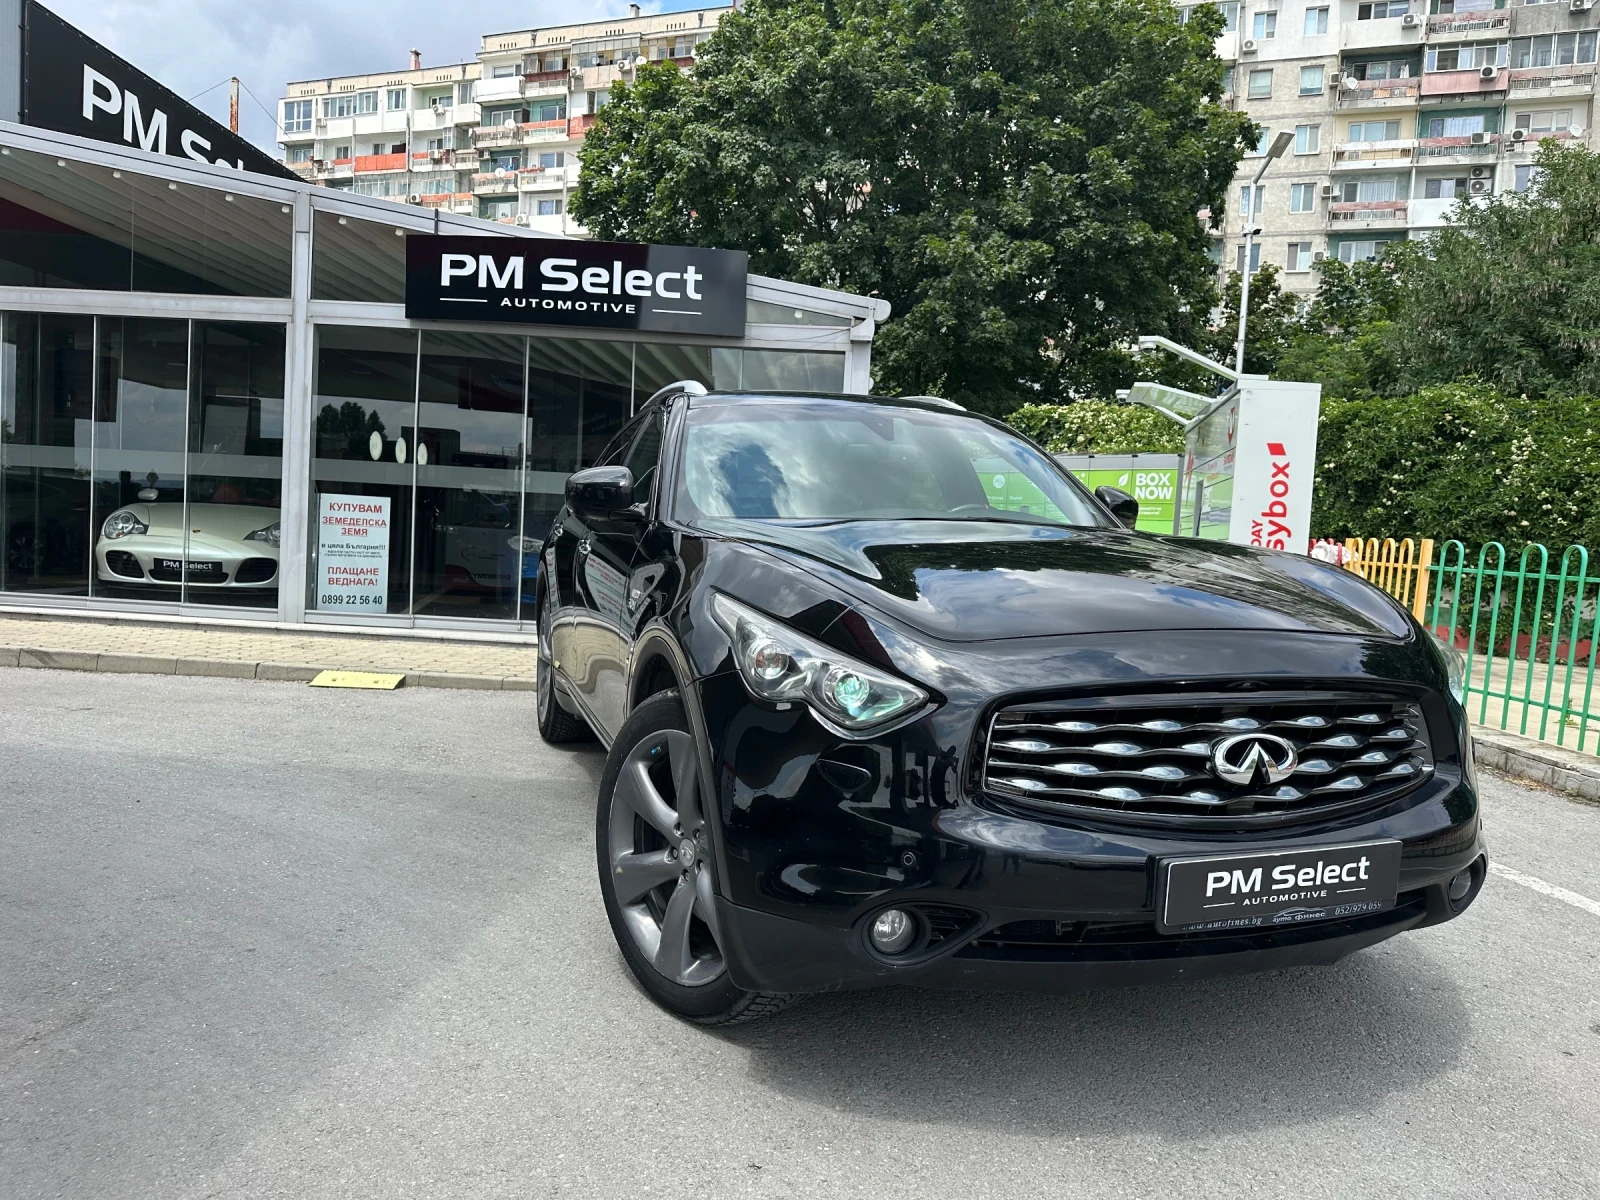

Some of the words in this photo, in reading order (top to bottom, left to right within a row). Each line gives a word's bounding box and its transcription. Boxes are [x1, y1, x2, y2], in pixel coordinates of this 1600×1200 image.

[83, 63, 167, 155] PM
[440, 253, 524, 290] PM
[539, 257, 703, 301] Select
[499, 297, 637, 315] AUTOMOTIVE
[1135, 472, 1172, 486] BOX
[1134, 486, 1174, 500] NOW
[329, 502, 383, 514] КУПУВАМ
[322, 516, 387, 527] ЗЕМЕДЕЛСКА
[341, 527, 368, 536] ЗЕМЯ
[163, 560, 180, 568] PM
[327, 566, 380, 576] ПЛАЩАНЕ
[328, 577, 378, 587] ВЕДНАГА!
[321, 594, 344, 605] 0899
[345, 594, 357, 605] 22
[359, 595, 370, 605] 56
[372, 595, 383, 605] 40
[1205, 867, 1263, 897] PM
[1271, 856, 1371, 890] Select
[1242, 889, 1328, 906] AUTOMOTIVE
